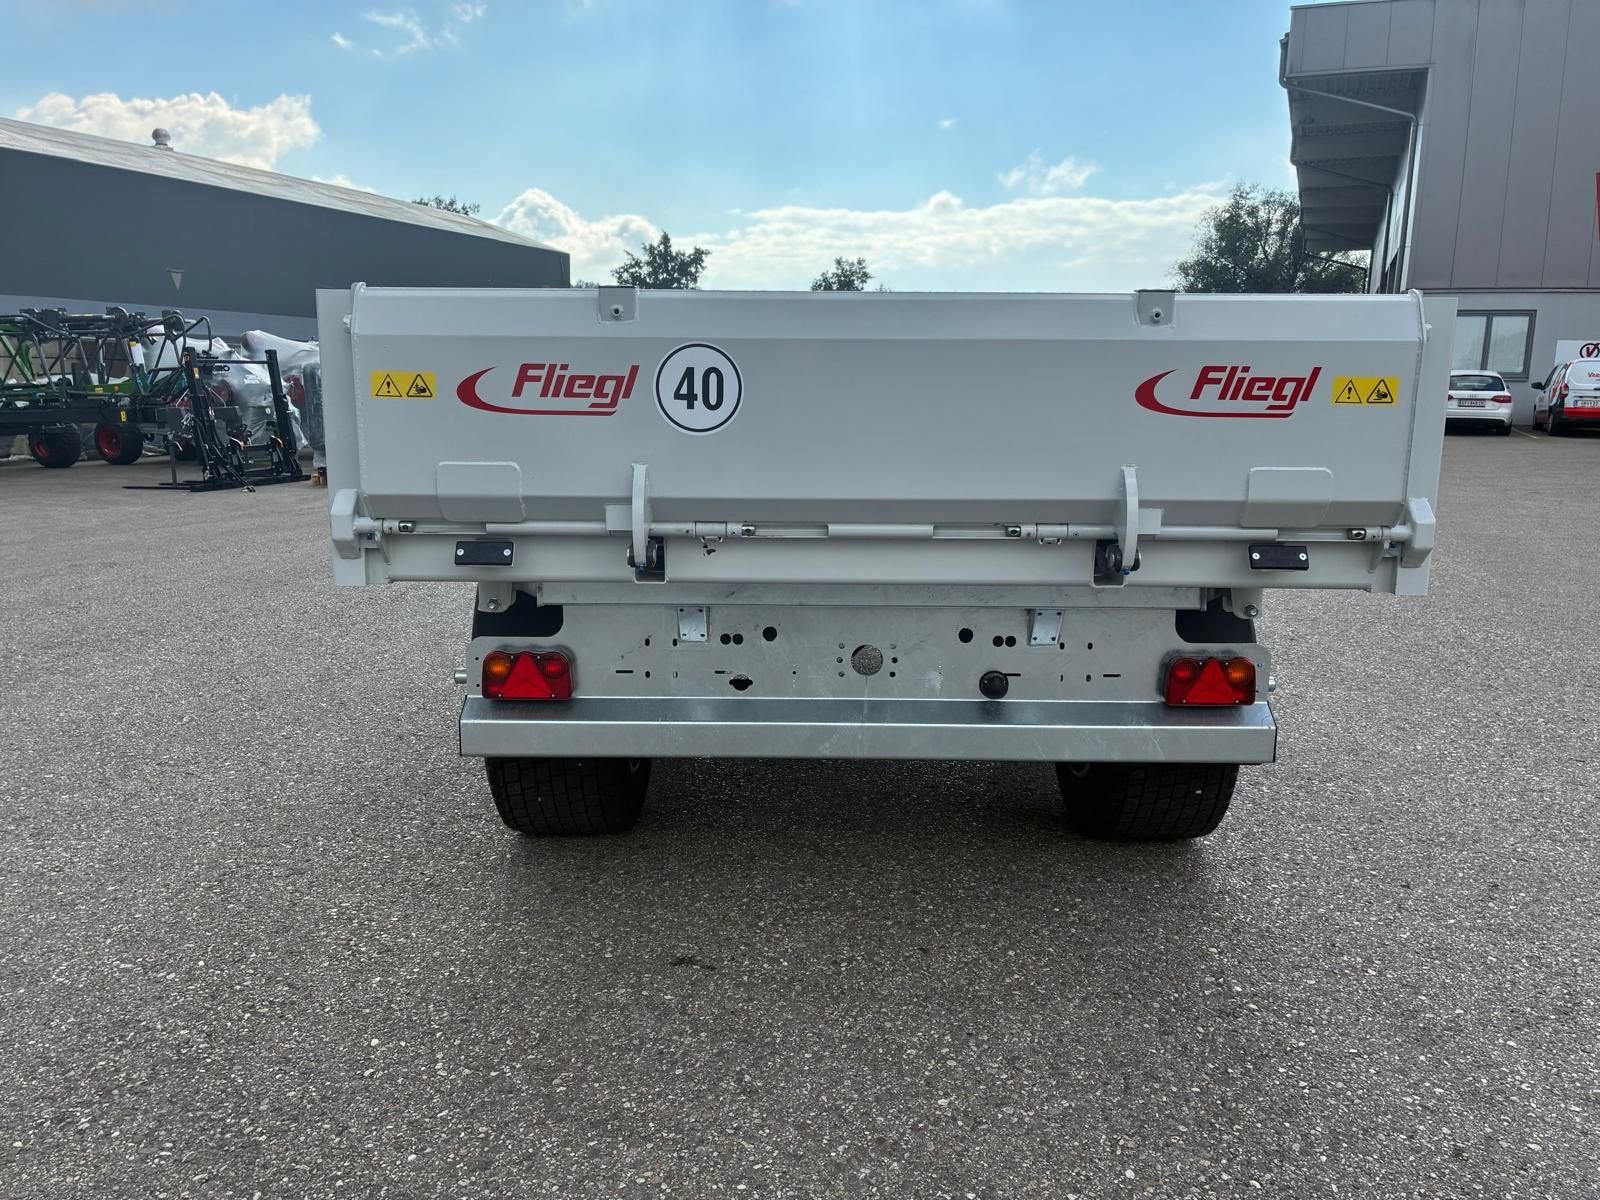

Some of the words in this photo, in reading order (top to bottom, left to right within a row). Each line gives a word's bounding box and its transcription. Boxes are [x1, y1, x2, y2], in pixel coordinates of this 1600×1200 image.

[511, 363, 640, 409] Fliegl
[673, 366, 724, 410] 40
[1190, 365, 1322, 411] Fliegl
